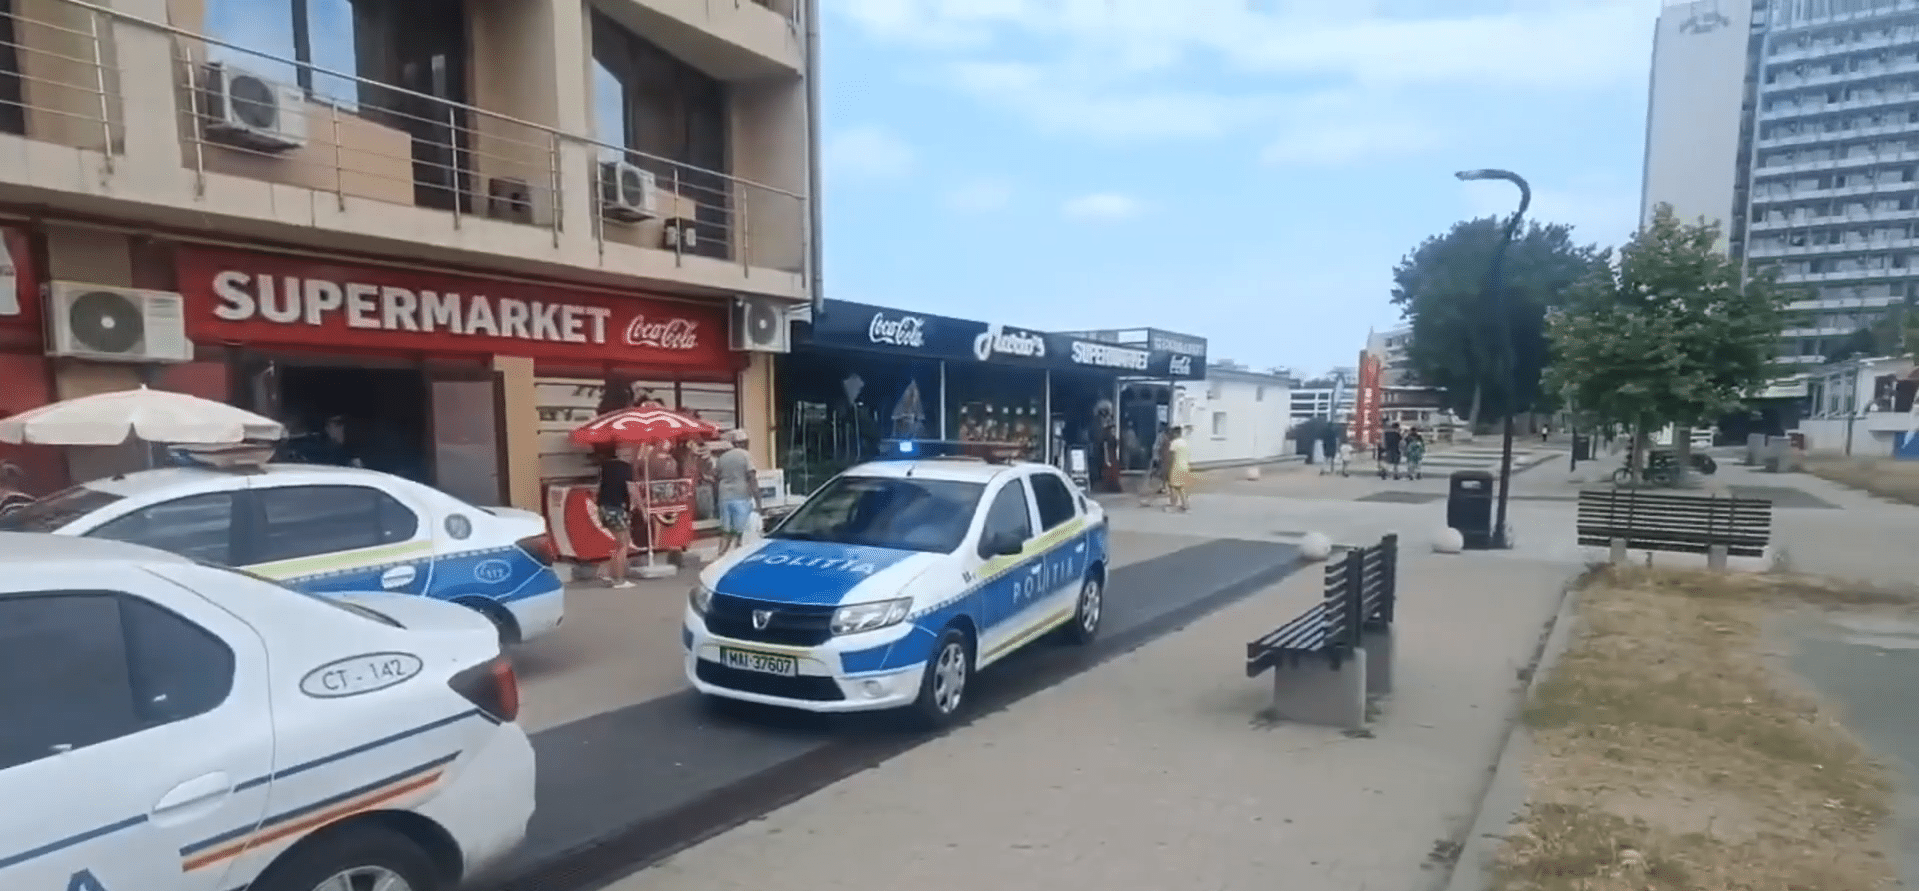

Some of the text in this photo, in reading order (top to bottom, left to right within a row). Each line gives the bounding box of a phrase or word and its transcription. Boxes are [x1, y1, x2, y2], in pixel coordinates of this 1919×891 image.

[213, 271, 611, 344] SUPERMARKET
[322, 669, 347, 690] CT
[369, 659, 406, 679] 142
